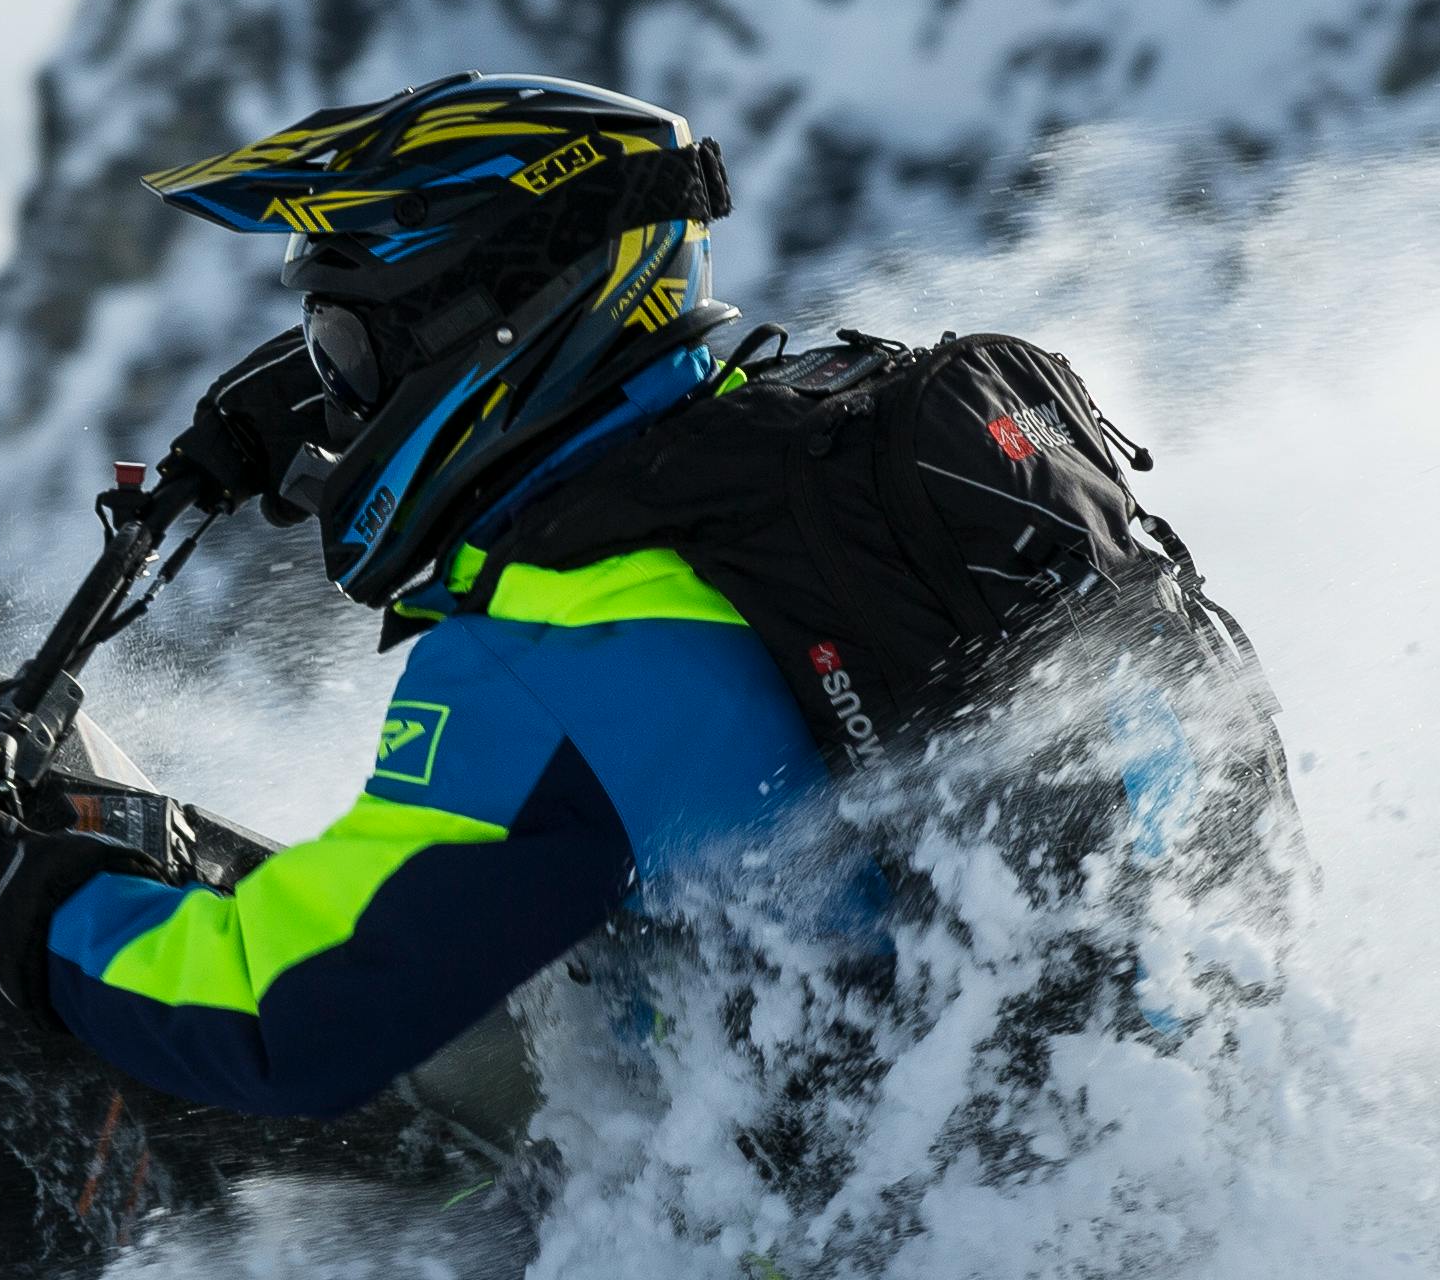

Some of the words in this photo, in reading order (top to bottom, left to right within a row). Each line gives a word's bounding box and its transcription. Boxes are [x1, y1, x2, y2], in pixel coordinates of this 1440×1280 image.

[522, 141, 597, 190] 509
[1026, 422, 1075, 452] PULSE
[354, 486, 396, 544] 509
